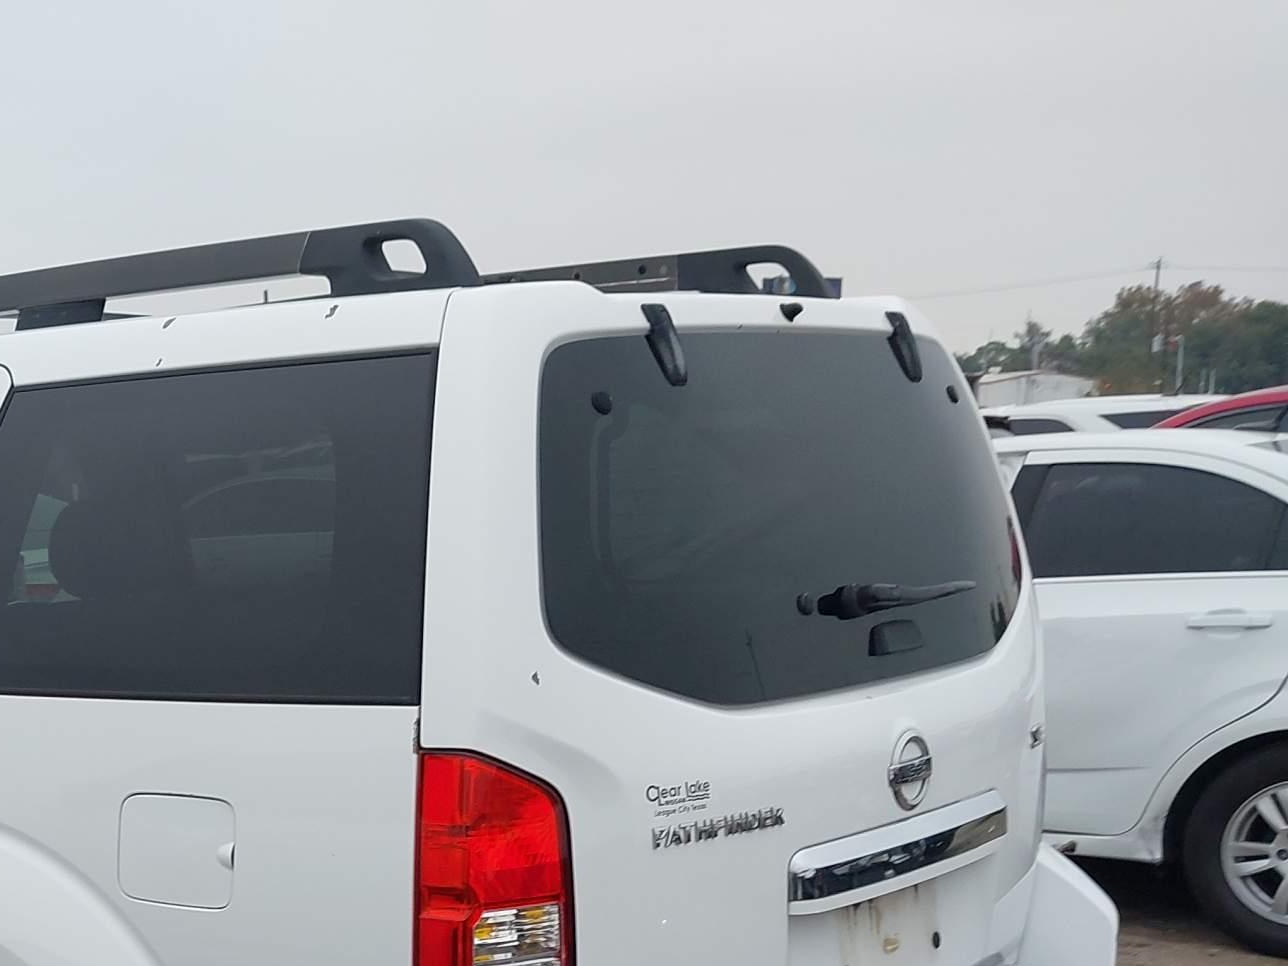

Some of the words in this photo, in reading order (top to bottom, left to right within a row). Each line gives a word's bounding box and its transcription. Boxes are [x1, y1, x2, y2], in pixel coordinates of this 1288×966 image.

[646, 784, 682, 803] Clear
[685, 780, 711, 798] Lake
[651, 807, 785, 850] PATHFINDER
